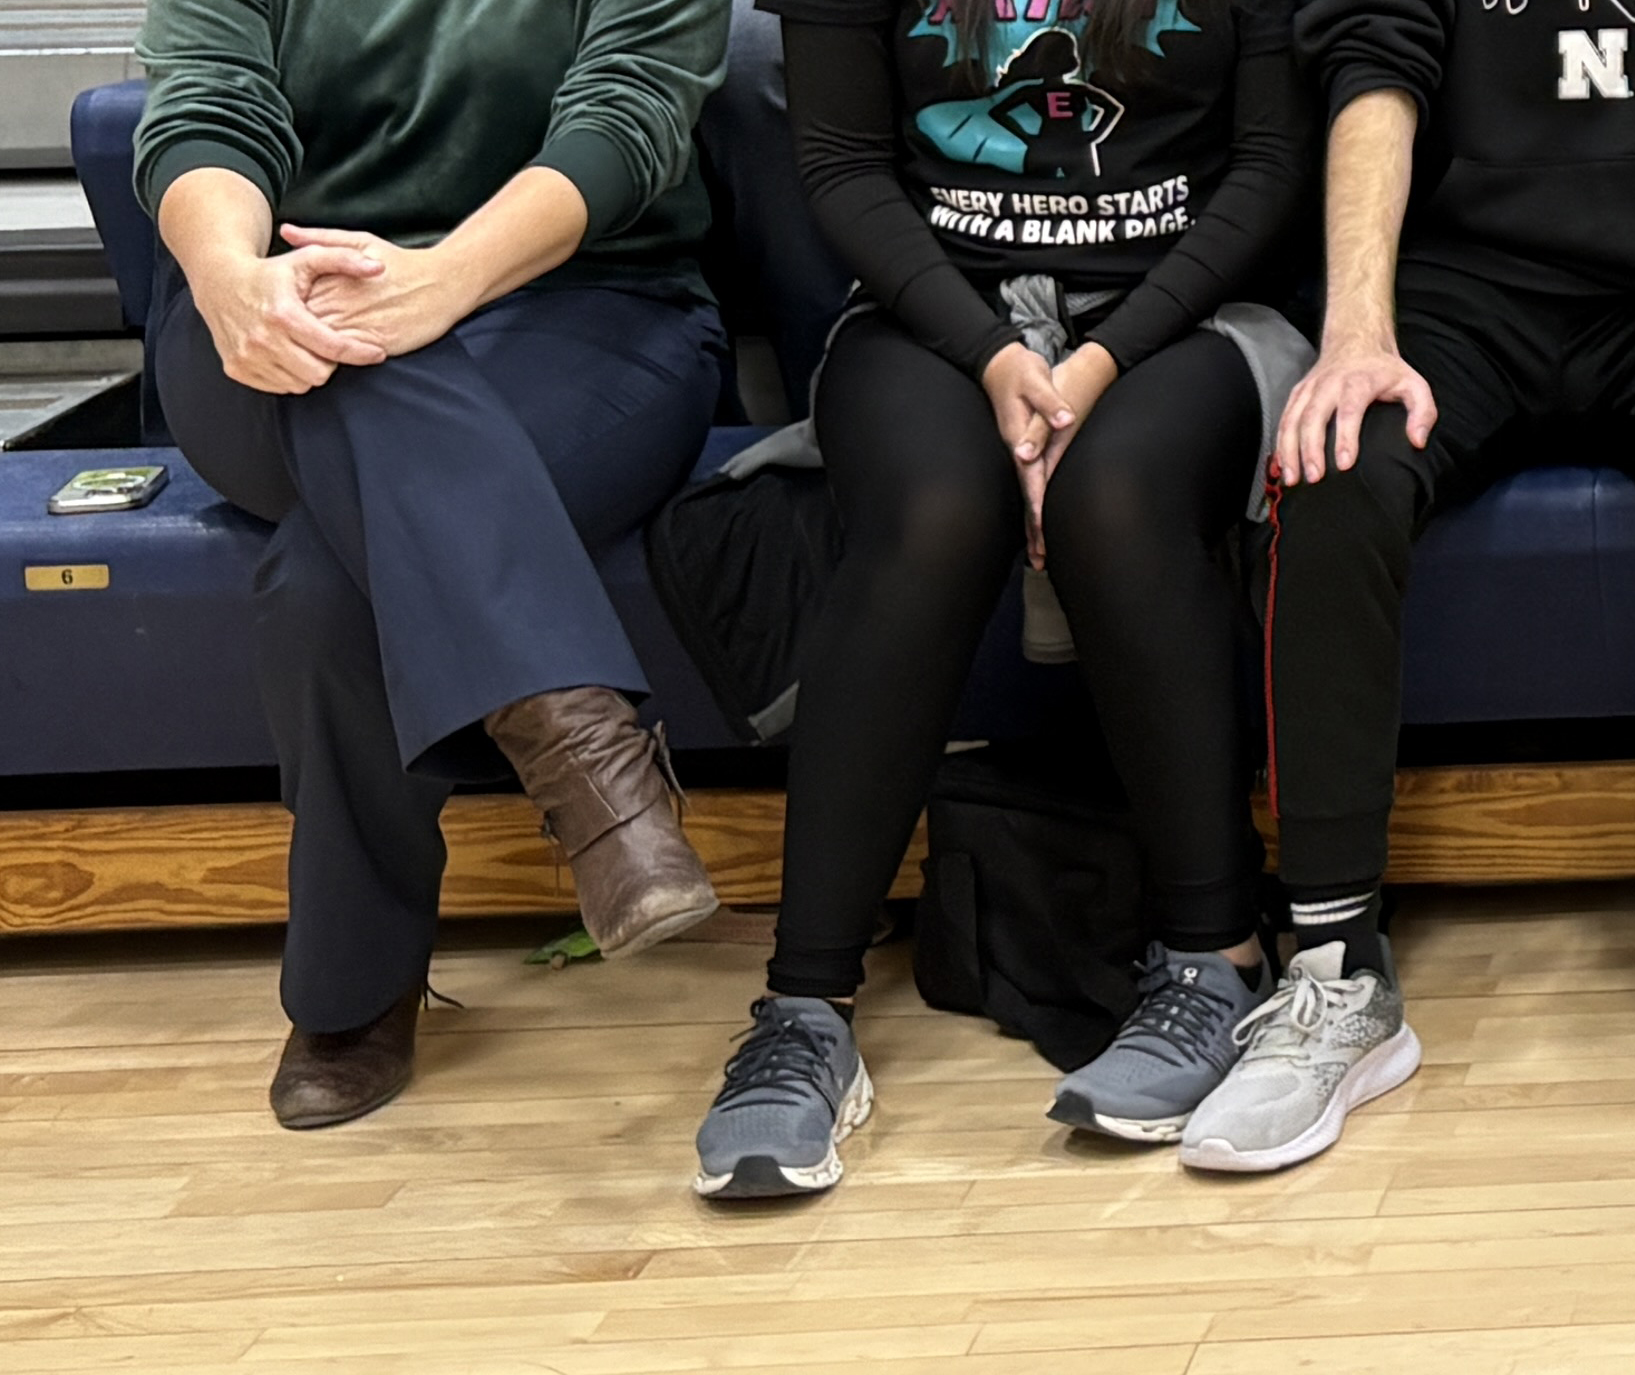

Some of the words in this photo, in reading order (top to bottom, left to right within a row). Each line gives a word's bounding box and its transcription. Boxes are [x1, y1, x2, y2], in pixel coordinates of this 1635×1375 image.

[1557, 28, 1630, 100] N
[1046, 92, 1074, 118] E
[930, 186, 1004, 217] EVERY
[1012, 193, 1089, 216] HERO
[1096, 175, 1189, 216] STARTS
[930, 204, 994, 238] WITH
[994, 219, 1015, 243] A
[1021, 219, 1117, 245] BLANK
[60, 570, 74, 585] 6
